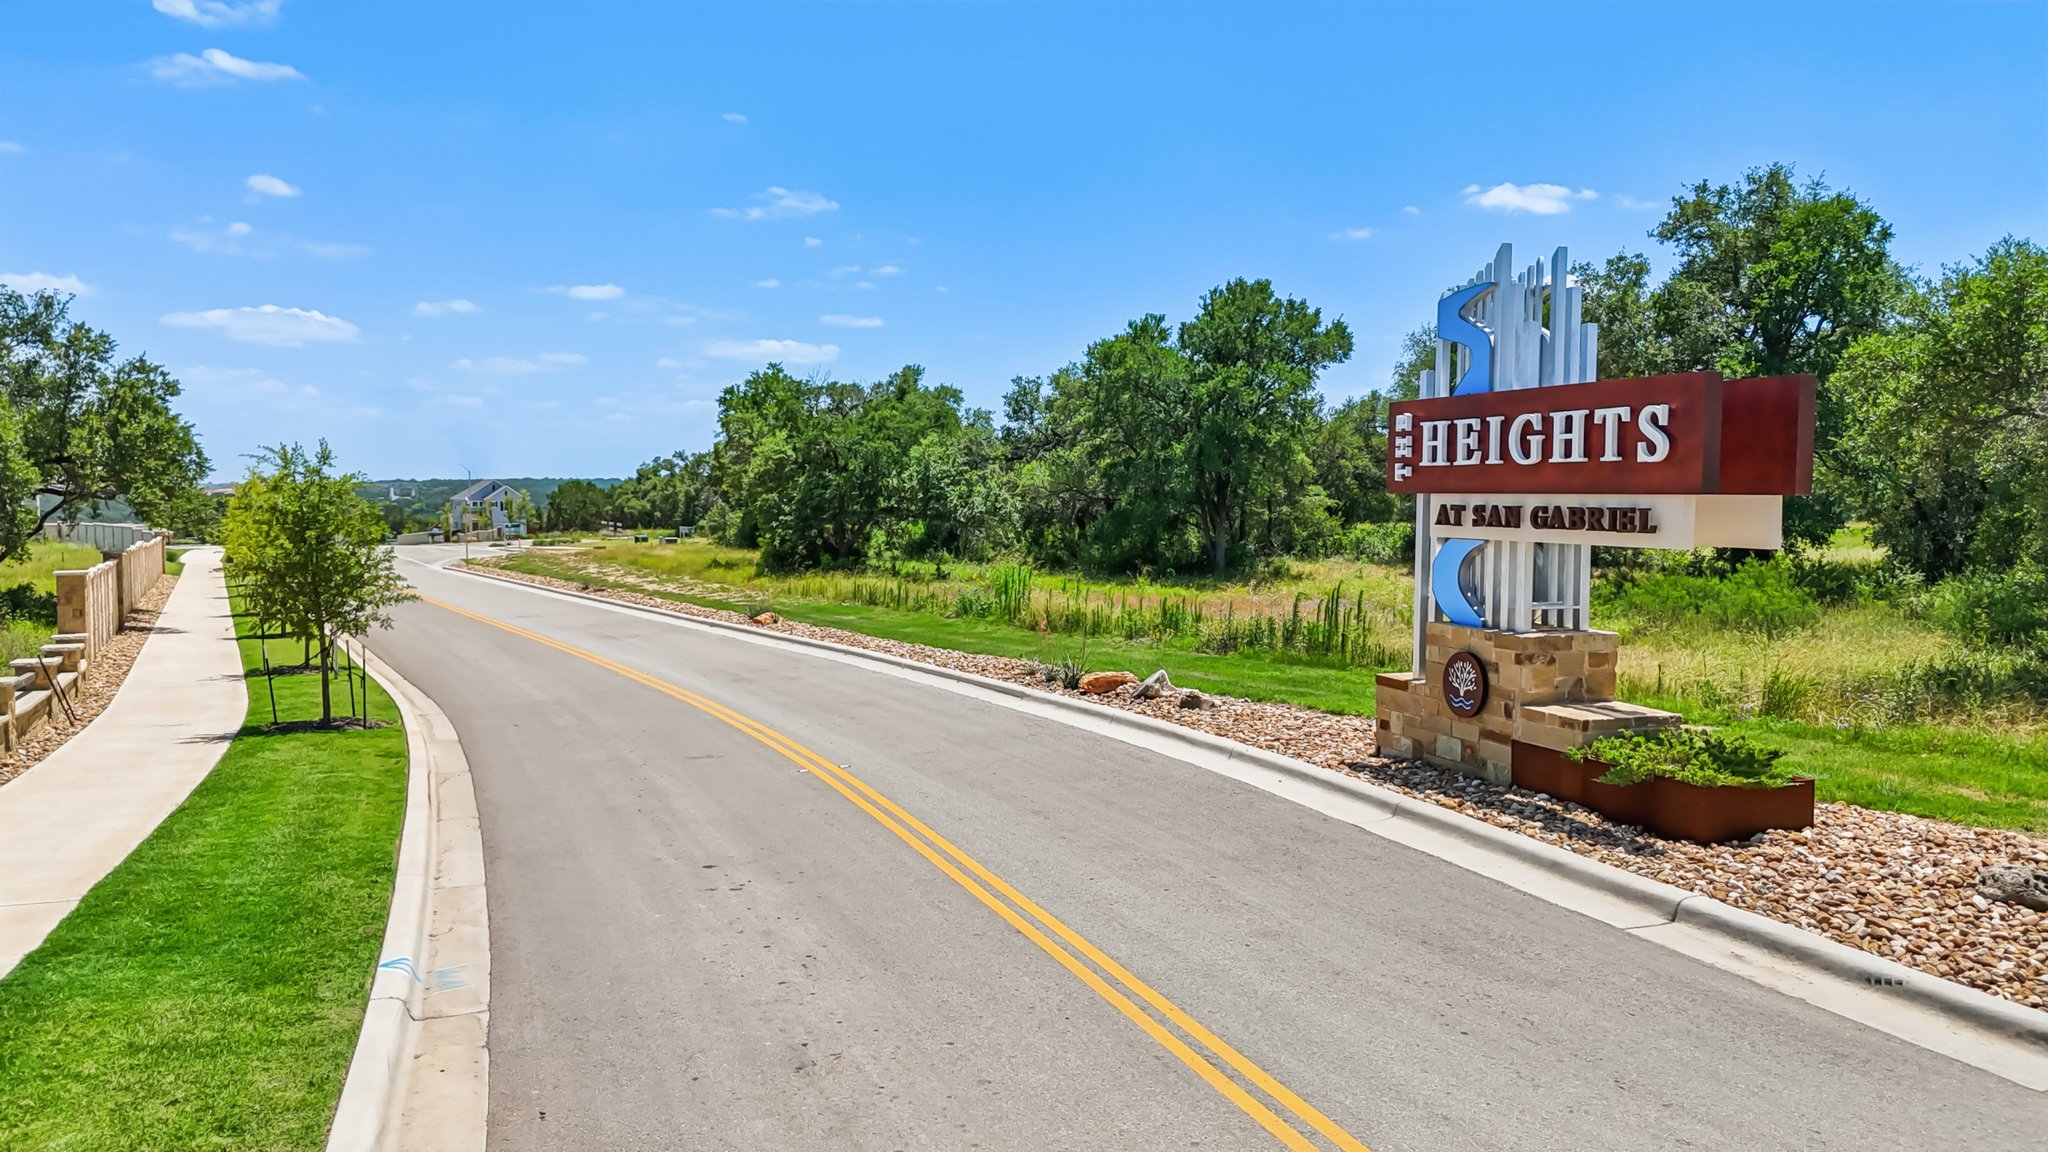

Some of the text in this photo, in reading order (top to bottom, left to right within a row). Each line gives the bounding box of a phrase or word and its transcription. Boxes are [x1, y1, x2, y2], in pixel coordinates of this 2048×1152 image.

[1395, 413, 1412, 481] THE
[1418, 404, 1670, 466] HEIGHTS
[1435, 504, 1658, 533] AT SAN GABRIEL
